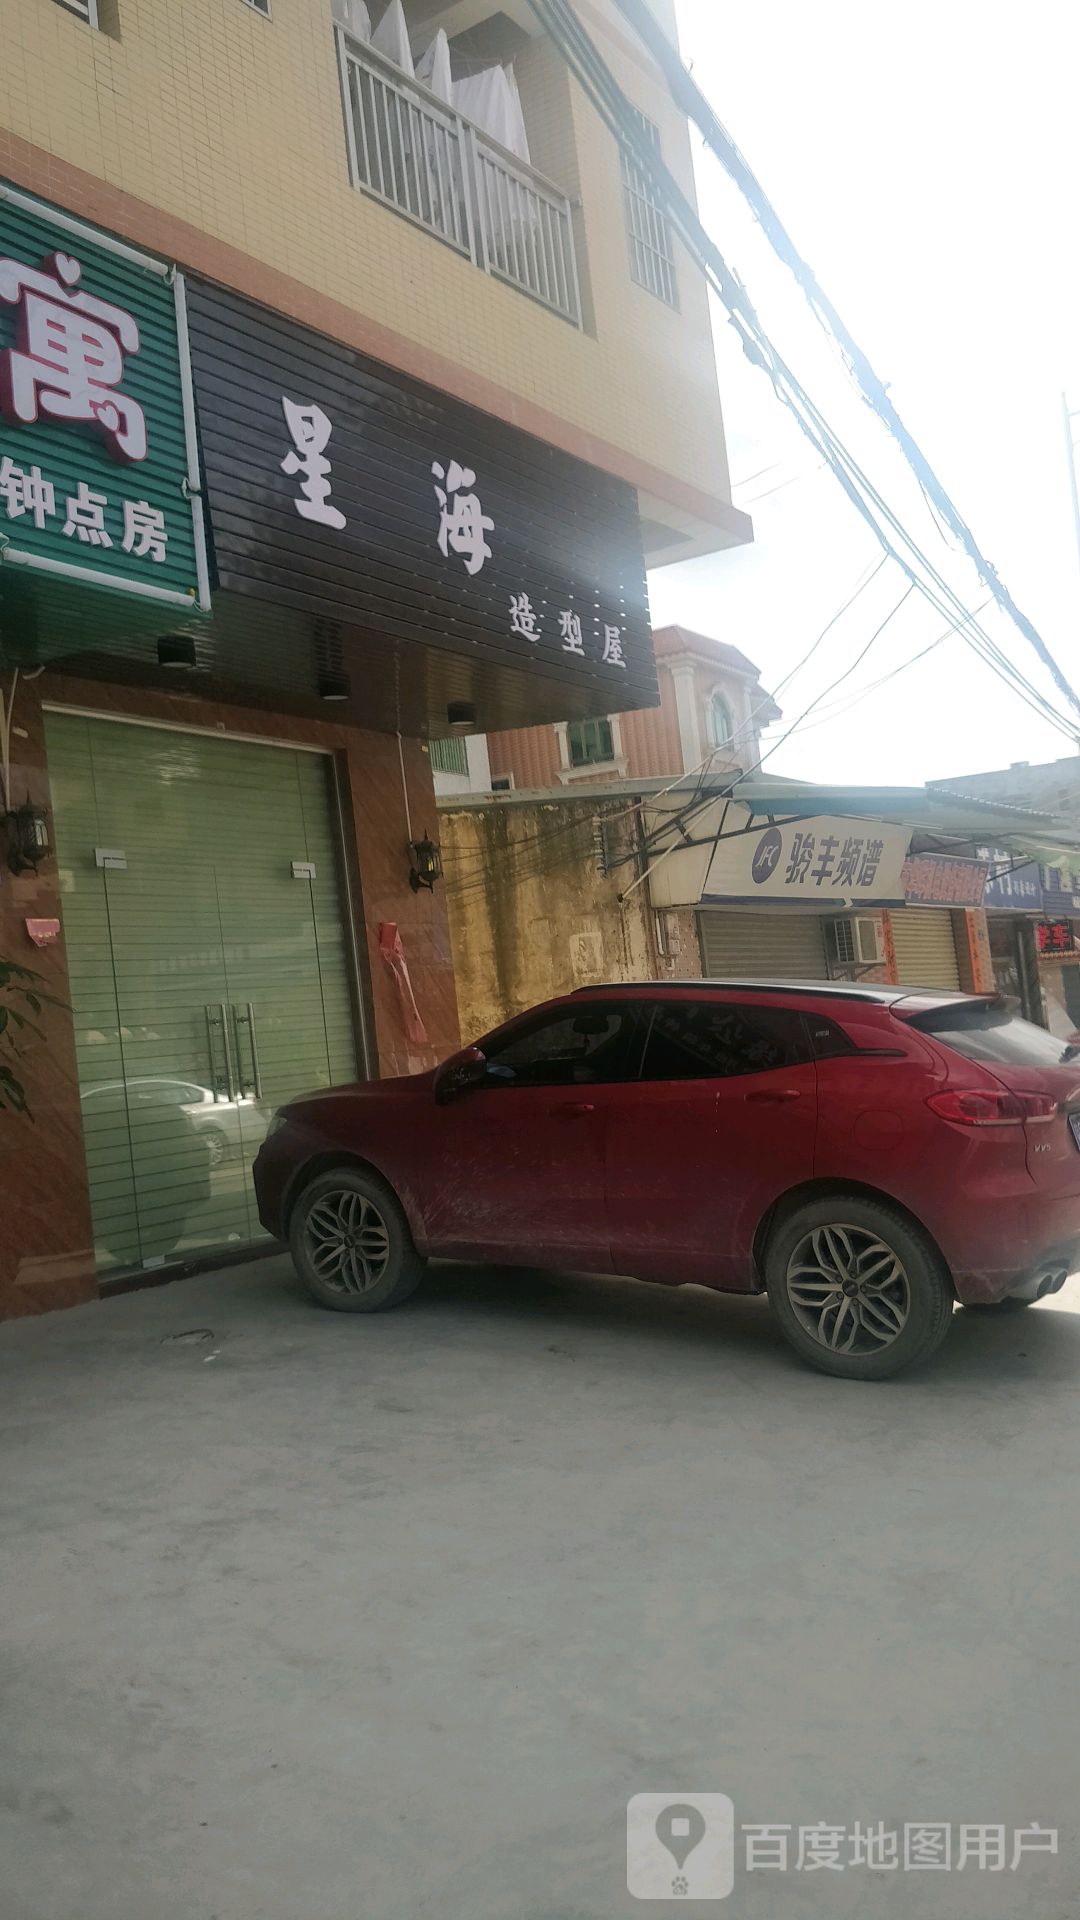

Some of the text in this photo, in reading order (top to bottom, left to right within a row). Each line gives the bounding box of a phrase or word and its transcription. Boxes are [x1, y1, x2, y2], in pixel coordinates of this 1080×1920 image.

[0, 252, 148, 463] 寓
[0, 455, 168, 562] 钟点房
[280, 396, 495, 575] 星海
[508, 593, 627, 669] 造型屋
[785, 832, 884, 887] 骏丰频谱
